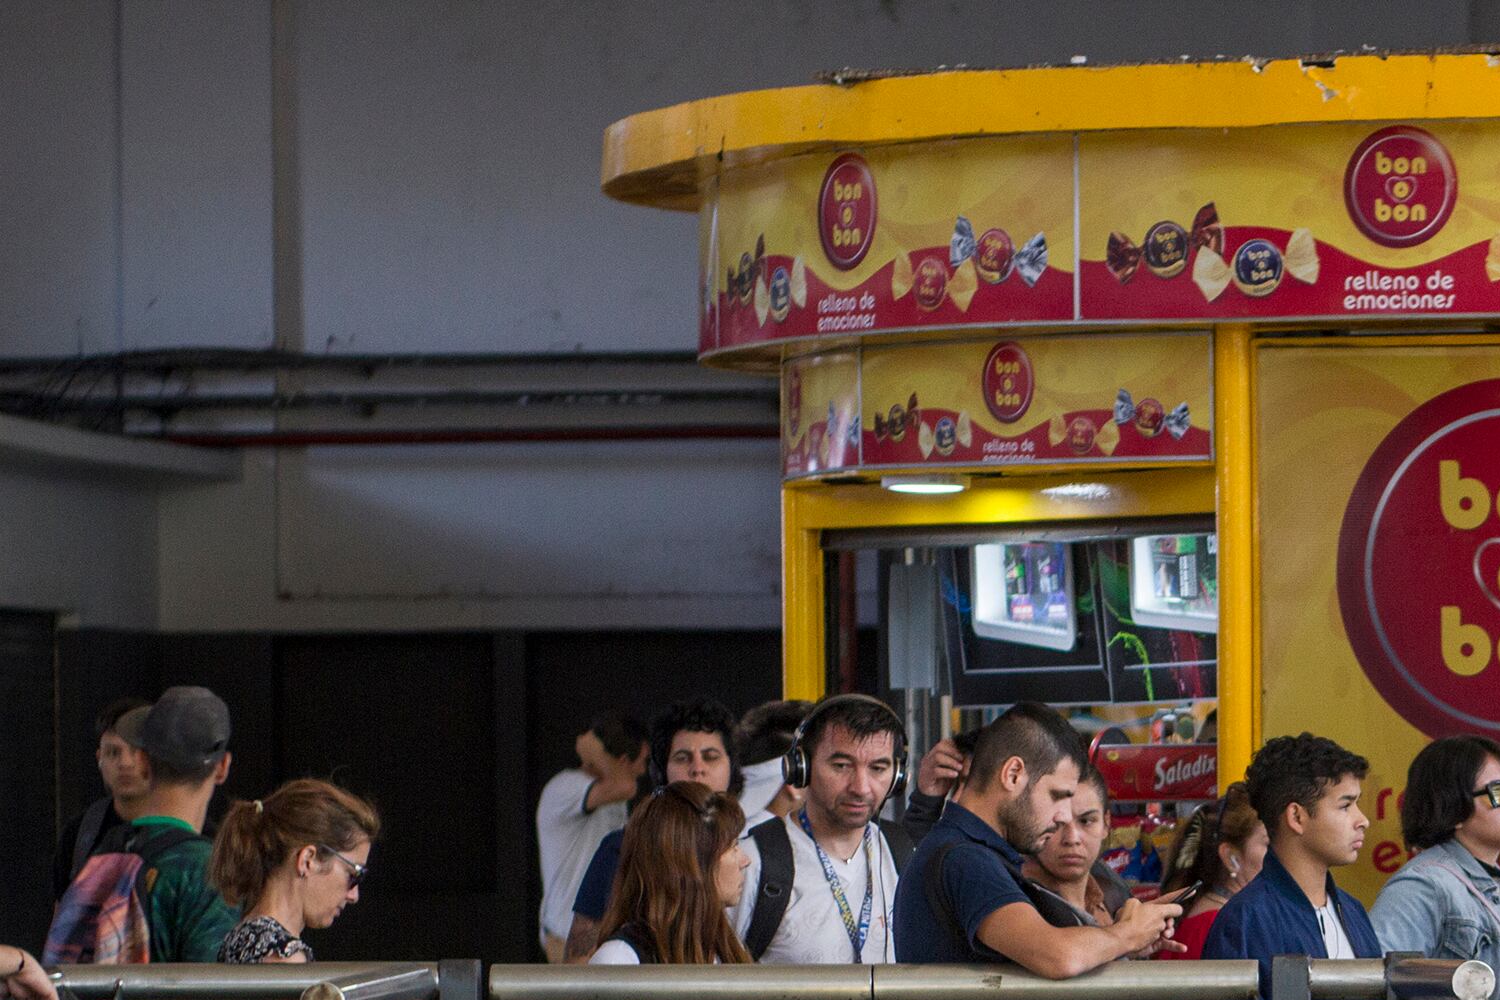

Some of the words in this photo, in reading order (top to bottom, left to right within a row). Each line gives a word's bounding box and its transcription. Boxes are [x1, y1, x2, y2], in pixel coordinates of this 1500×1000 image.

[1375, 152, 1427, 175] bon
[833, 178, 862, 201] bon
[1393, 182, 1409, 198] o
[1374, 199, 1427, 222] bon
[832, 223, 862, 247] bon
[1344, 271, 1419, 291] relleno
[1426, 270, 1454, 290] de
[818, 293, 857, 314] relleno
[860, 291, 876, 310] de
[1344, 291, 1456, 309] emociones
[817, 311, 876, 332] emociones
[1154, 754, 1216, 791] Saladix
